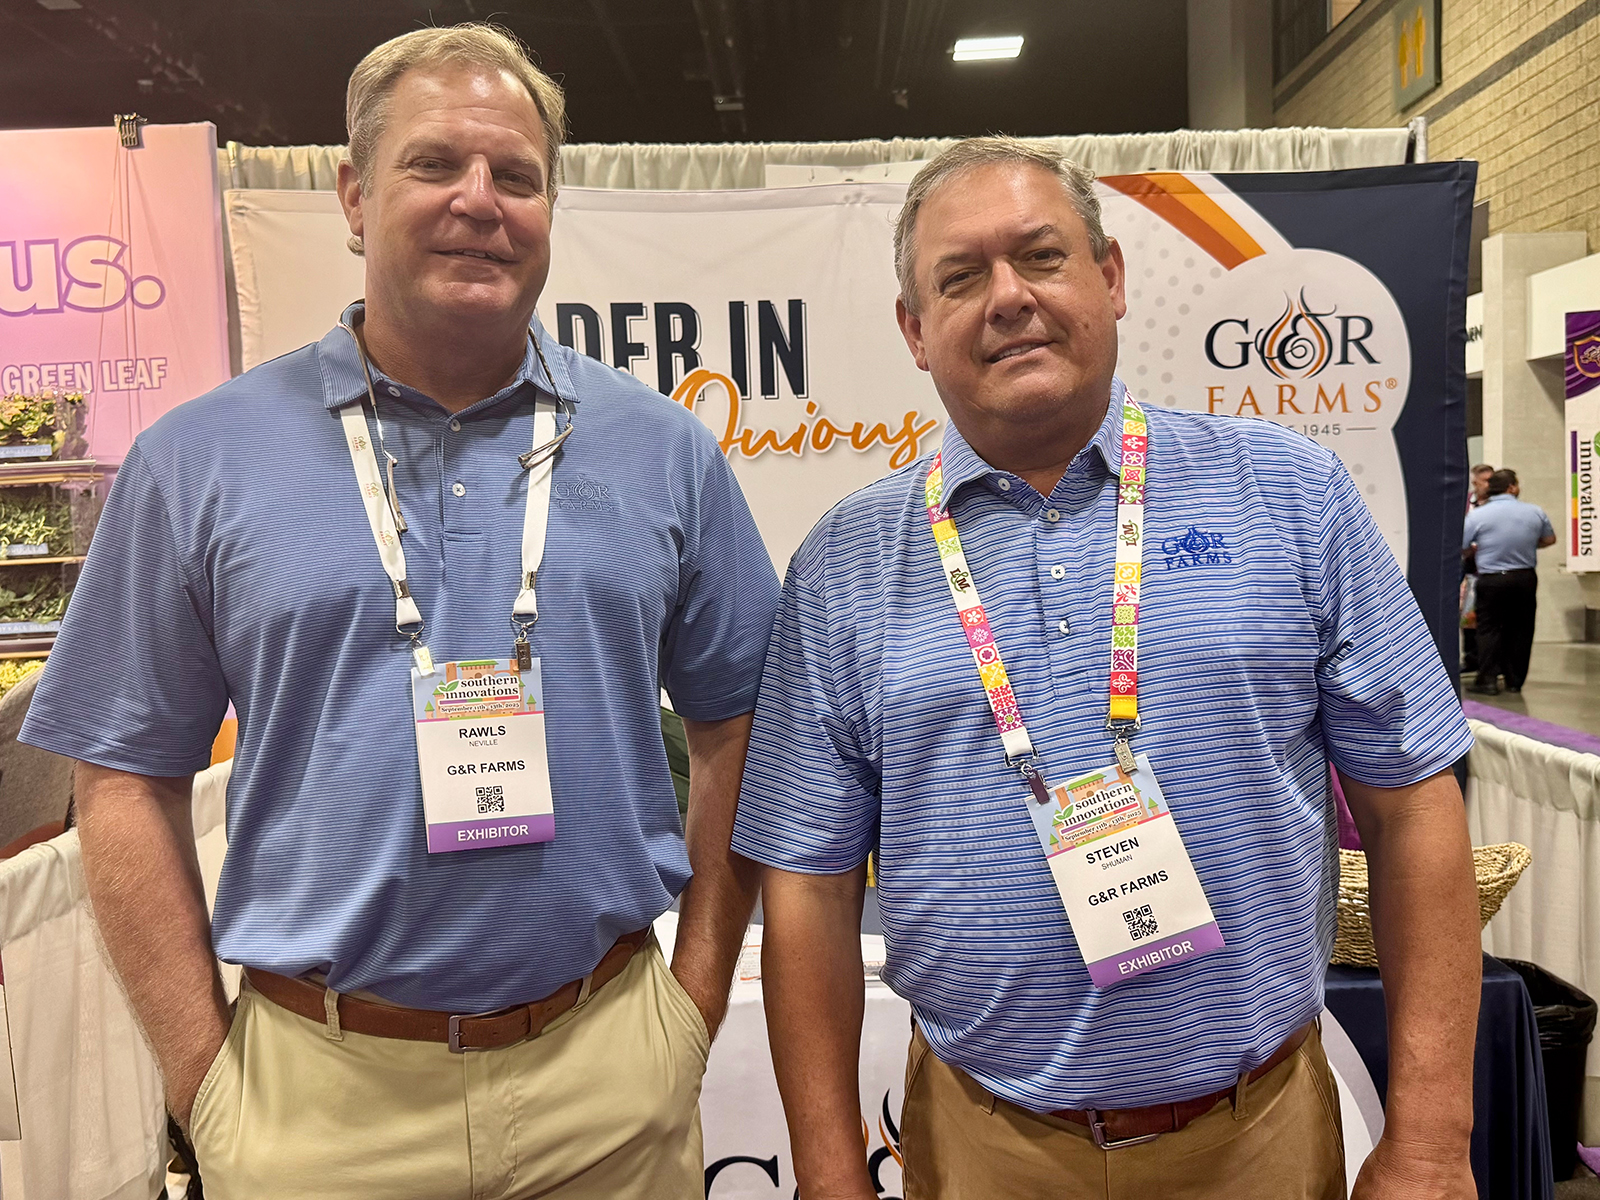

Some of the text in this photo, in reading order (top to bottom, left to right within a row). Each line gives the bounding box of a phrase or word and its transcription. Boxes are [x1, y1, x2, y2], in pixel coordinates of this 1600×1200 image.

[0, 235, 165, 317] us.
[1204, 285, 1381, 379] G&R
[556, 298, 809, 401] DER IN
[2, 357, 167, 395] GREEN LEAF
[671, 369, 937, 469] Onions
[1303, 424, 1341, 437] 1945
[1579, 440, 1597, 557] innovations
[1163, 551, 1233, 571] FARMS
[445, 686, 520, 700] innovations
[460, 675, 519, 688] southern
[441, 706, 473, 714] September
[458, 725, 507, 739] RAWLS
[469, 738, 499, 748] NEVILLE
[447, 760, 526, 776] G&R FARMS
[1064, 794, 1137, 828] innovations
[1075, 784, 1132, 811] southern
[457, 824, 530, 842] EXHIBITOR
[1064, 827, 1096, 843] September
[1127, 809, 1142, 819] 2025
[1085, 836, 1140, 865] STEVEN
[1101, 854, 1133, 872] SHUMAN
[1088, 869, 1169, 907] G&R FARMS
[1117, 939, 1195, 976] EXHIBITOR
